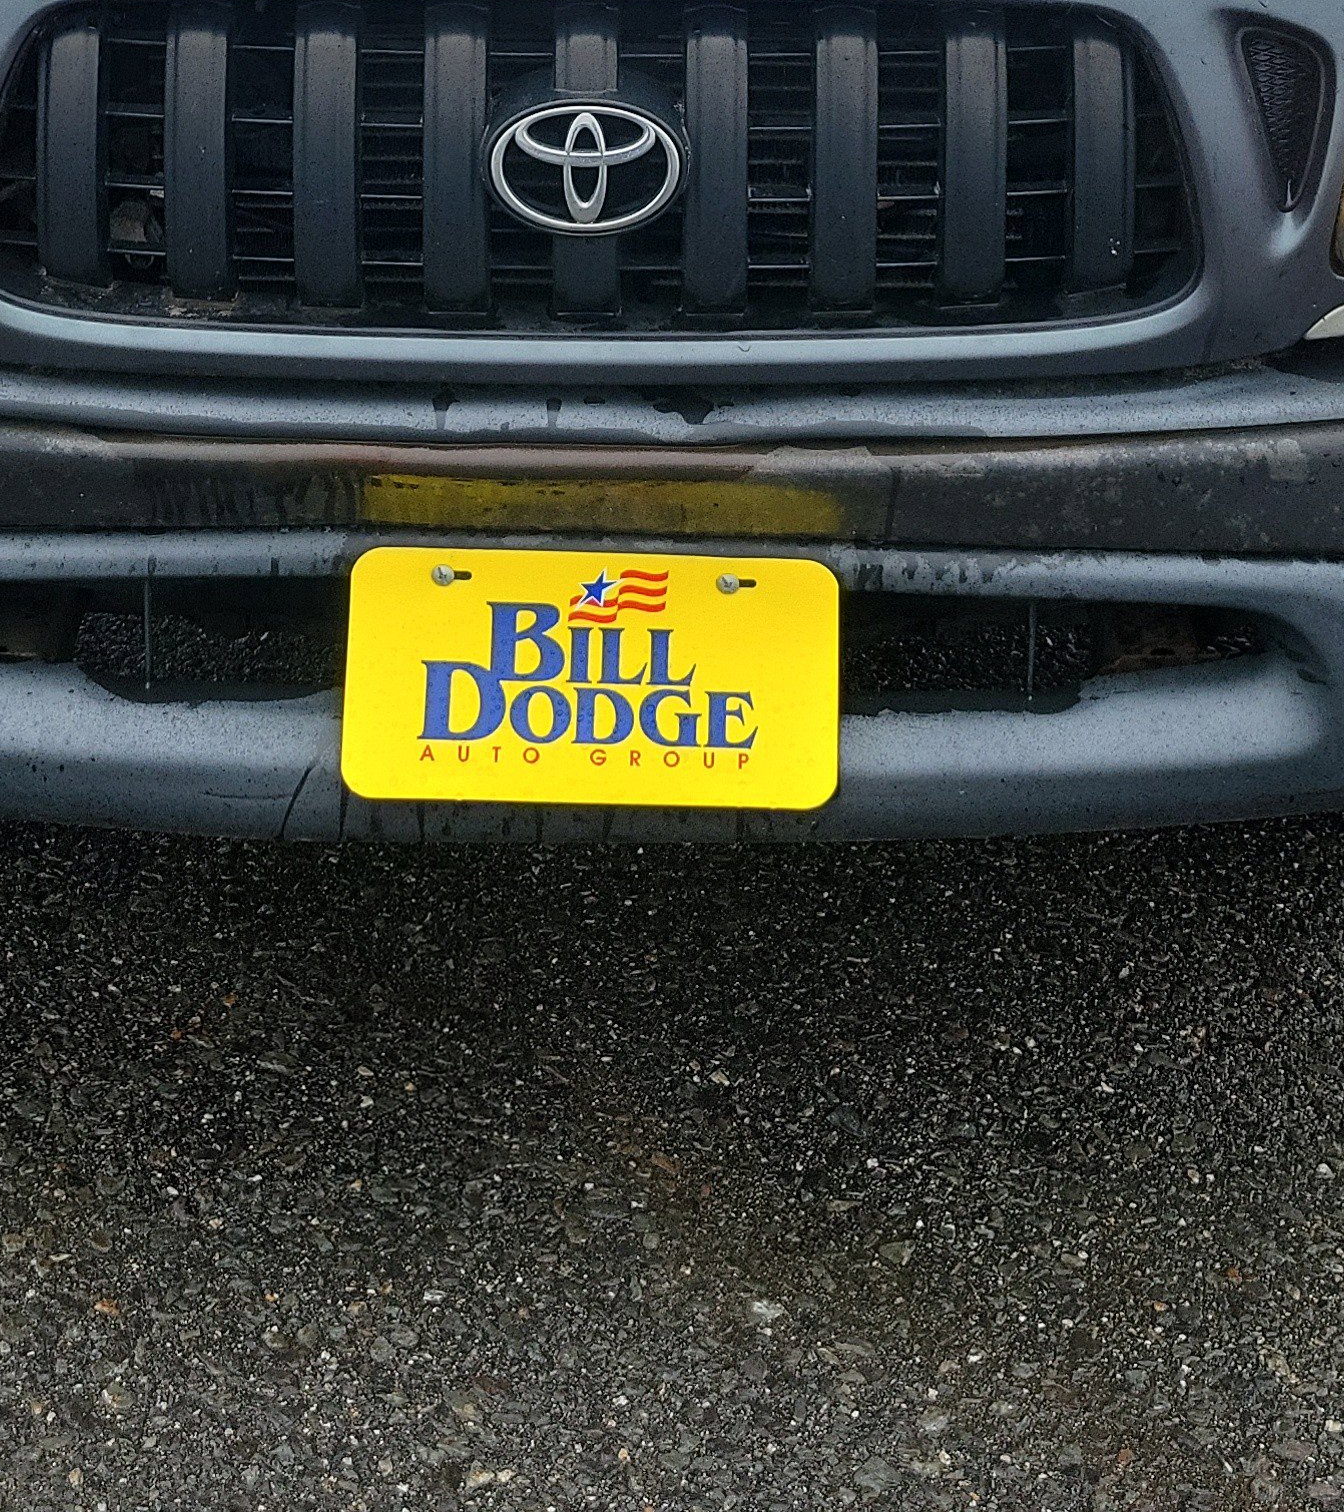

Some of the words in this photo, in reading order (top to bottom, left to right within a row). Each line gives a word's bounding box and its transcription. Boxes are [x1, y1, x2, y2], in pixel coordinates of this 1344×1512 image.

[486, 600, 696, 686] BILL
[417, 659, 758, 749] DODGE
[419, 744, 541, 764] AUTO
[589, 749, 751, 770] GROUP
